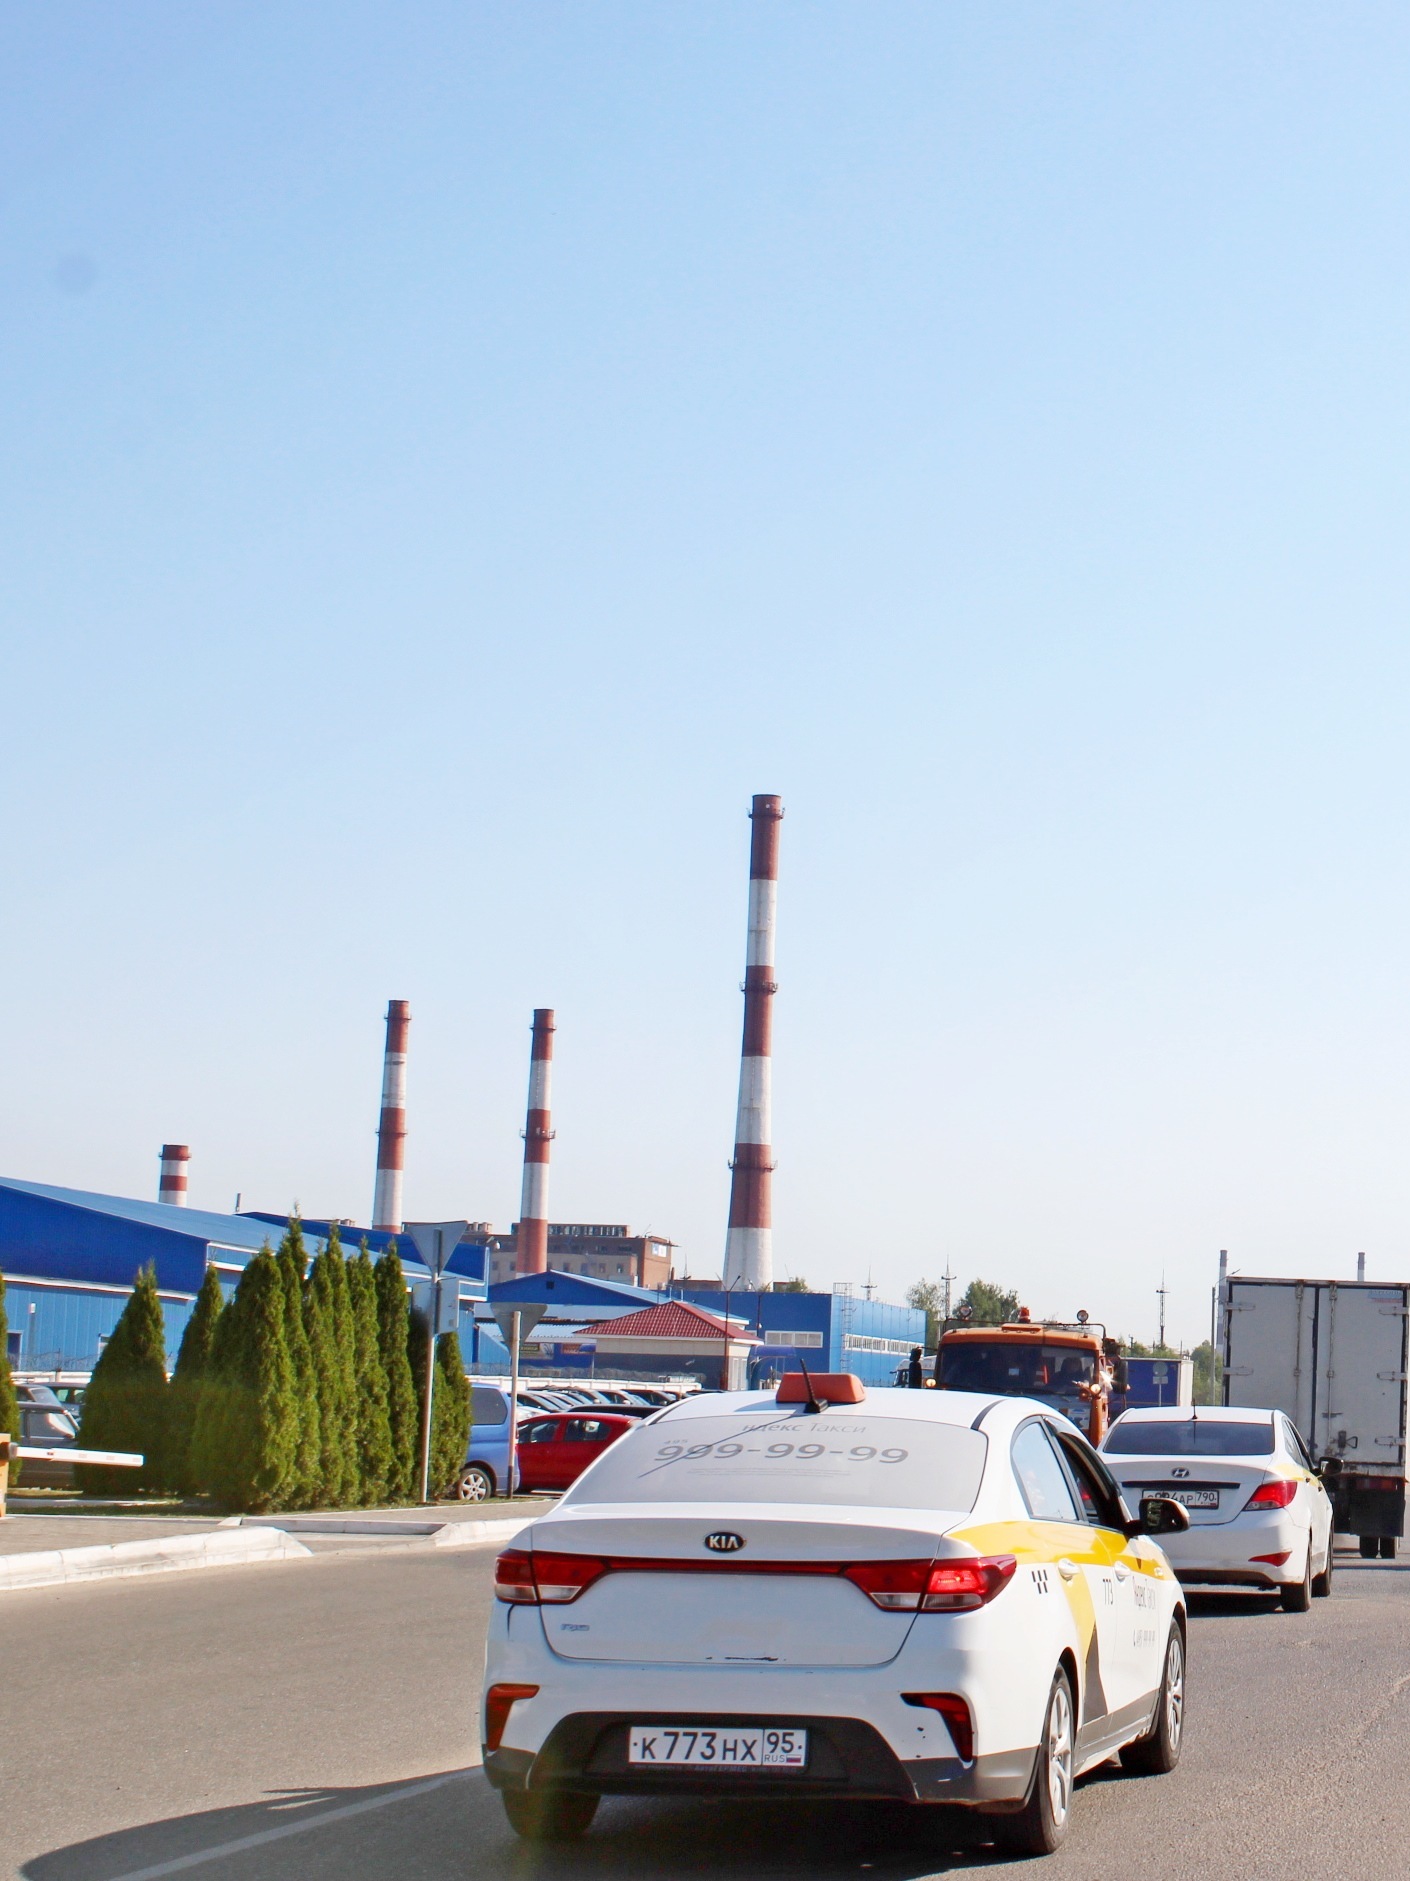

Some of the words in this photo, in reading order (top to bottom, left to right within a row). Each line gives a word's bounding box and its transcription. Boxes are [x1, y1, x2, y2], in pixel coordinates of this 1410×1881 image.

[809, 1421, 867, 1434] Такси
[653, 1442, 910, 1464] 999-99-99
[1196, 1491, 1215, 1502] 790
[709, 1535, 739, 1549] KIA
[766, 1731, 795, 1754] 95
[763, 1753, 786, 1763] RUS
